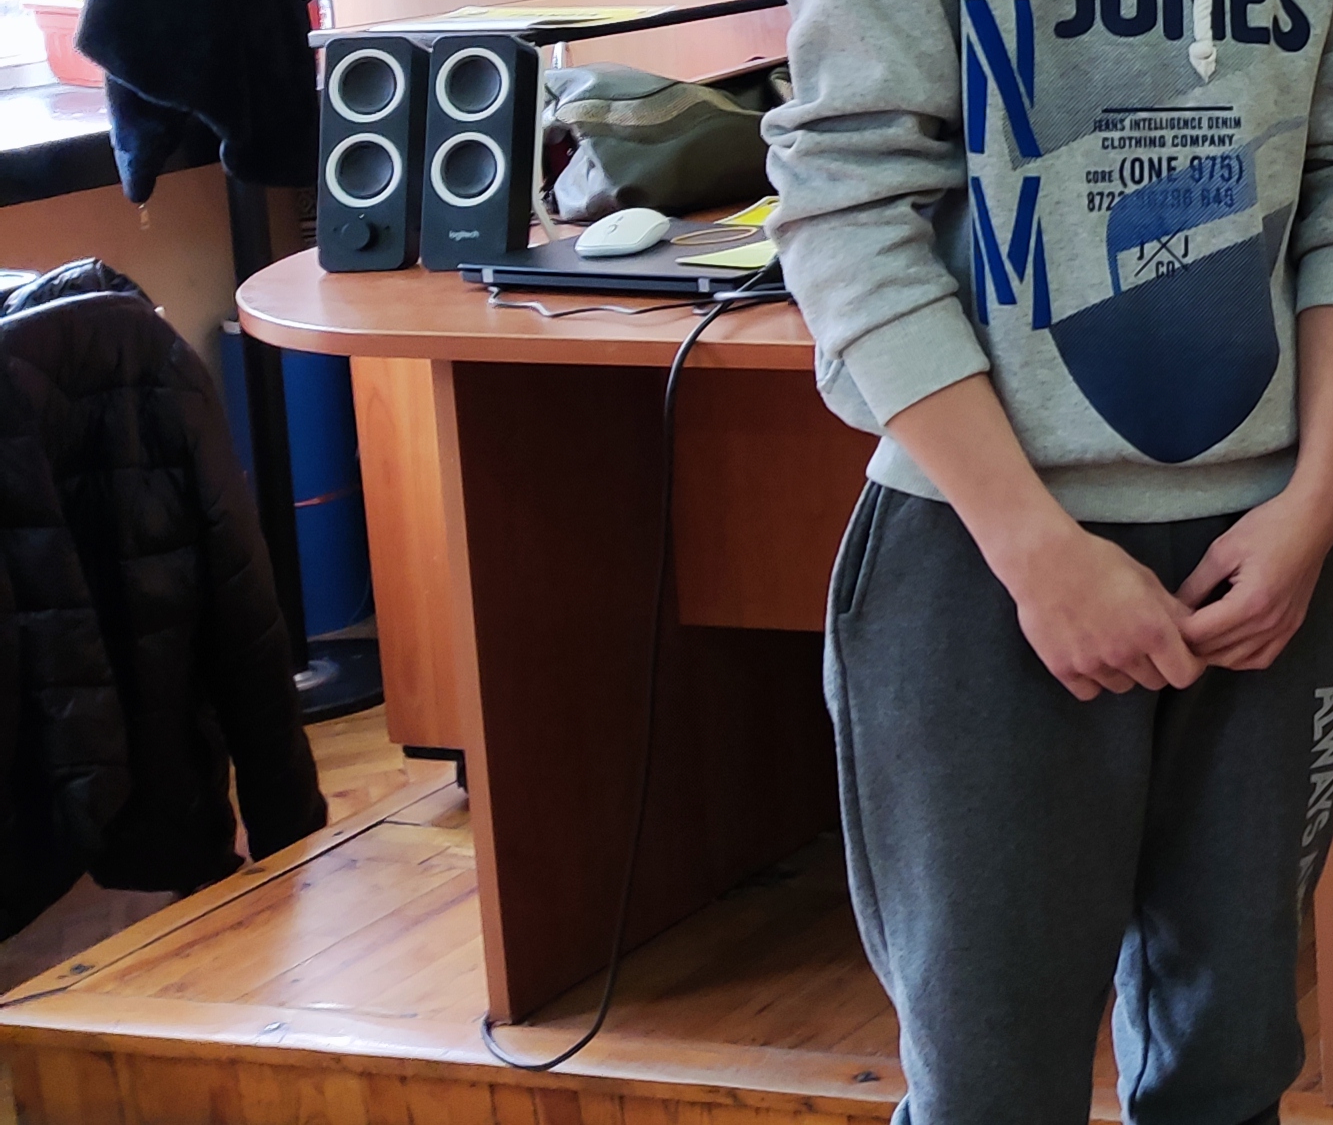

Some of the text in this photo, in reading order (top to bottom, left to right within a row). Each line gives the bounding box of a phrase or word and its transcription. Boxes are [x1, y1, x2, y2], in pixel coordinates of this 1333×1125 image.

[1093, 116, 1242, 133] JEANS INTELLIGENCE DENIM
[1101, 133, 1236, 150] CLOTHING COMPANY
[1085, 169, 1115, 184] CORE
